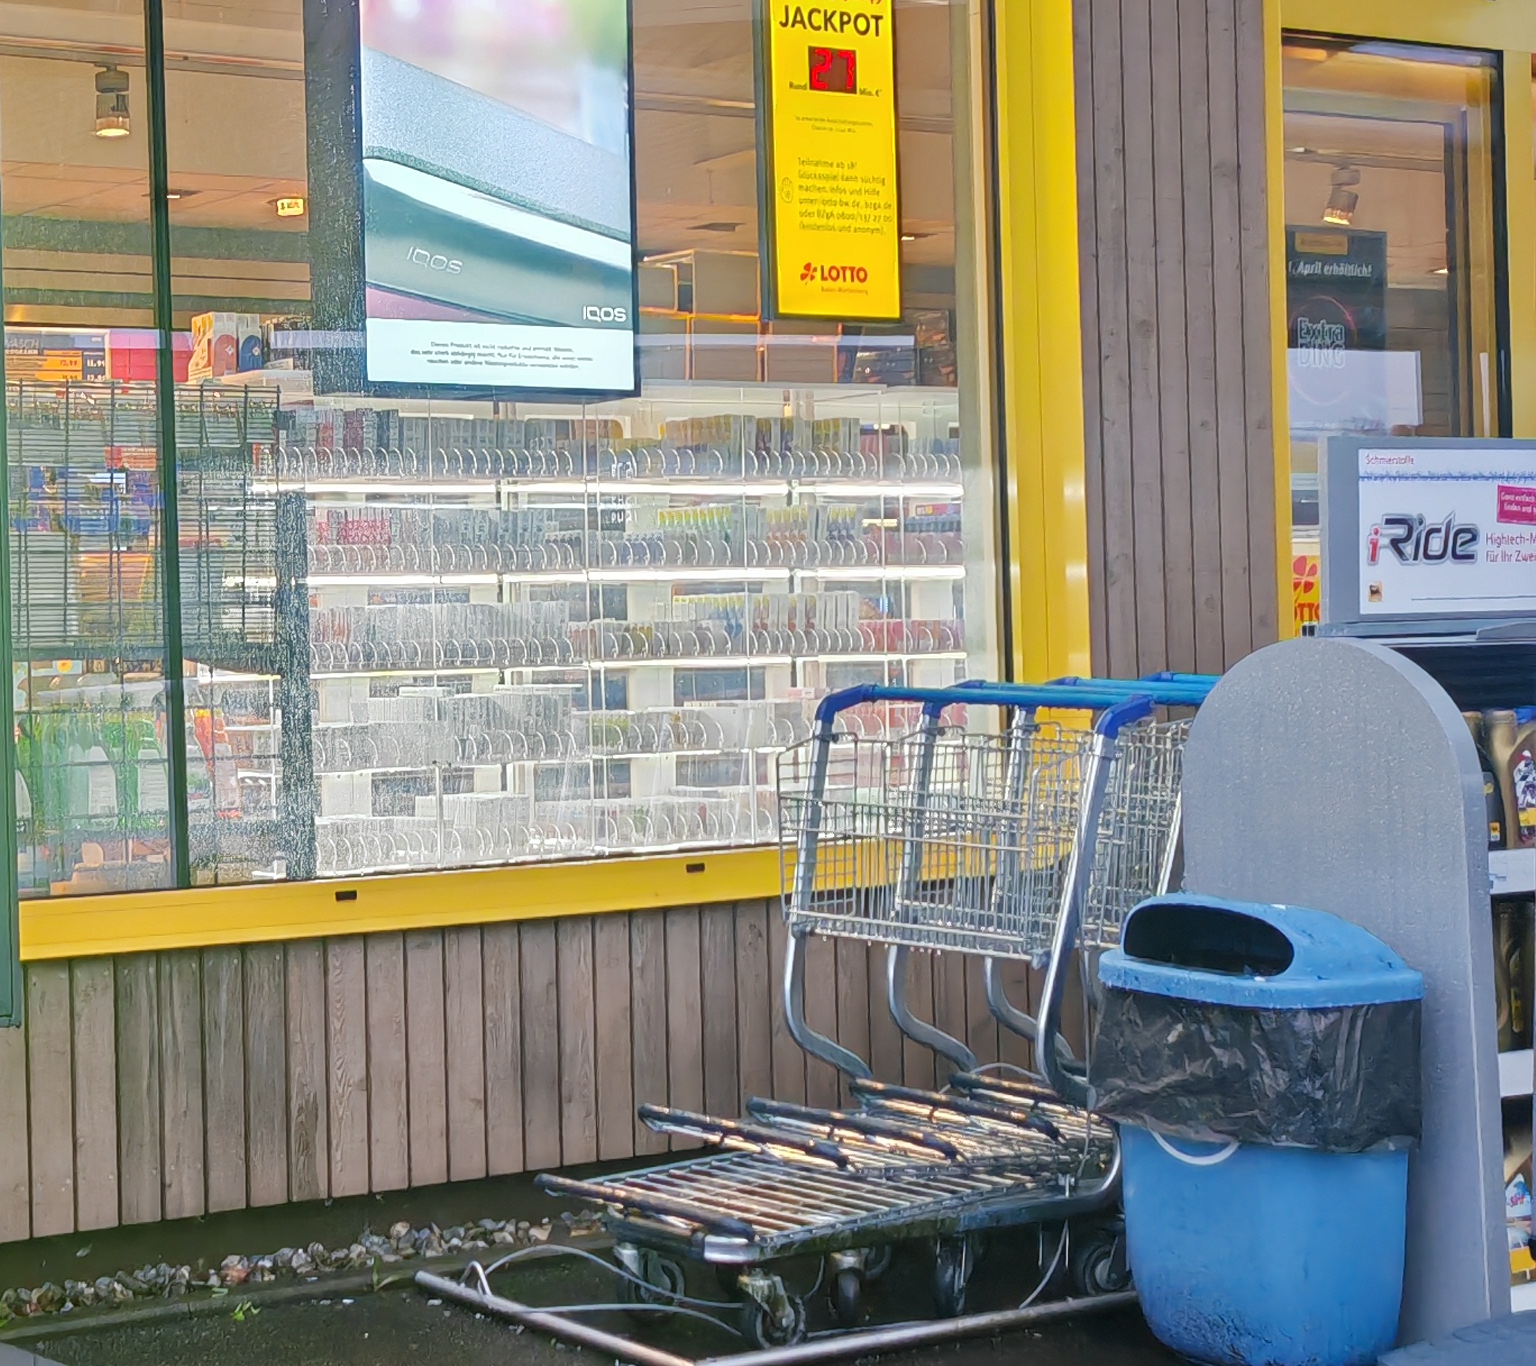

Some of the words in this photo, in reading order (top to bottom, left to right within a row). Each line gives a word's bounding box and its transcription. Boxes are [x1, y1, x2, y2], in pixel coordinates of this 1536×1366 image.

[779, 5, 883, 37] JACKPOT
[811, 48, 854, 90] 27
[406, 245, 463, 275] IQOS
[1297, 260, 1322, 276] April
[820, 264, 868, 283] LOTTO
[582, 305, 627, 323] IQOS
[1368, 512, 1479, 565] iRide
[1501, 549, 1513, 563] Ihr
